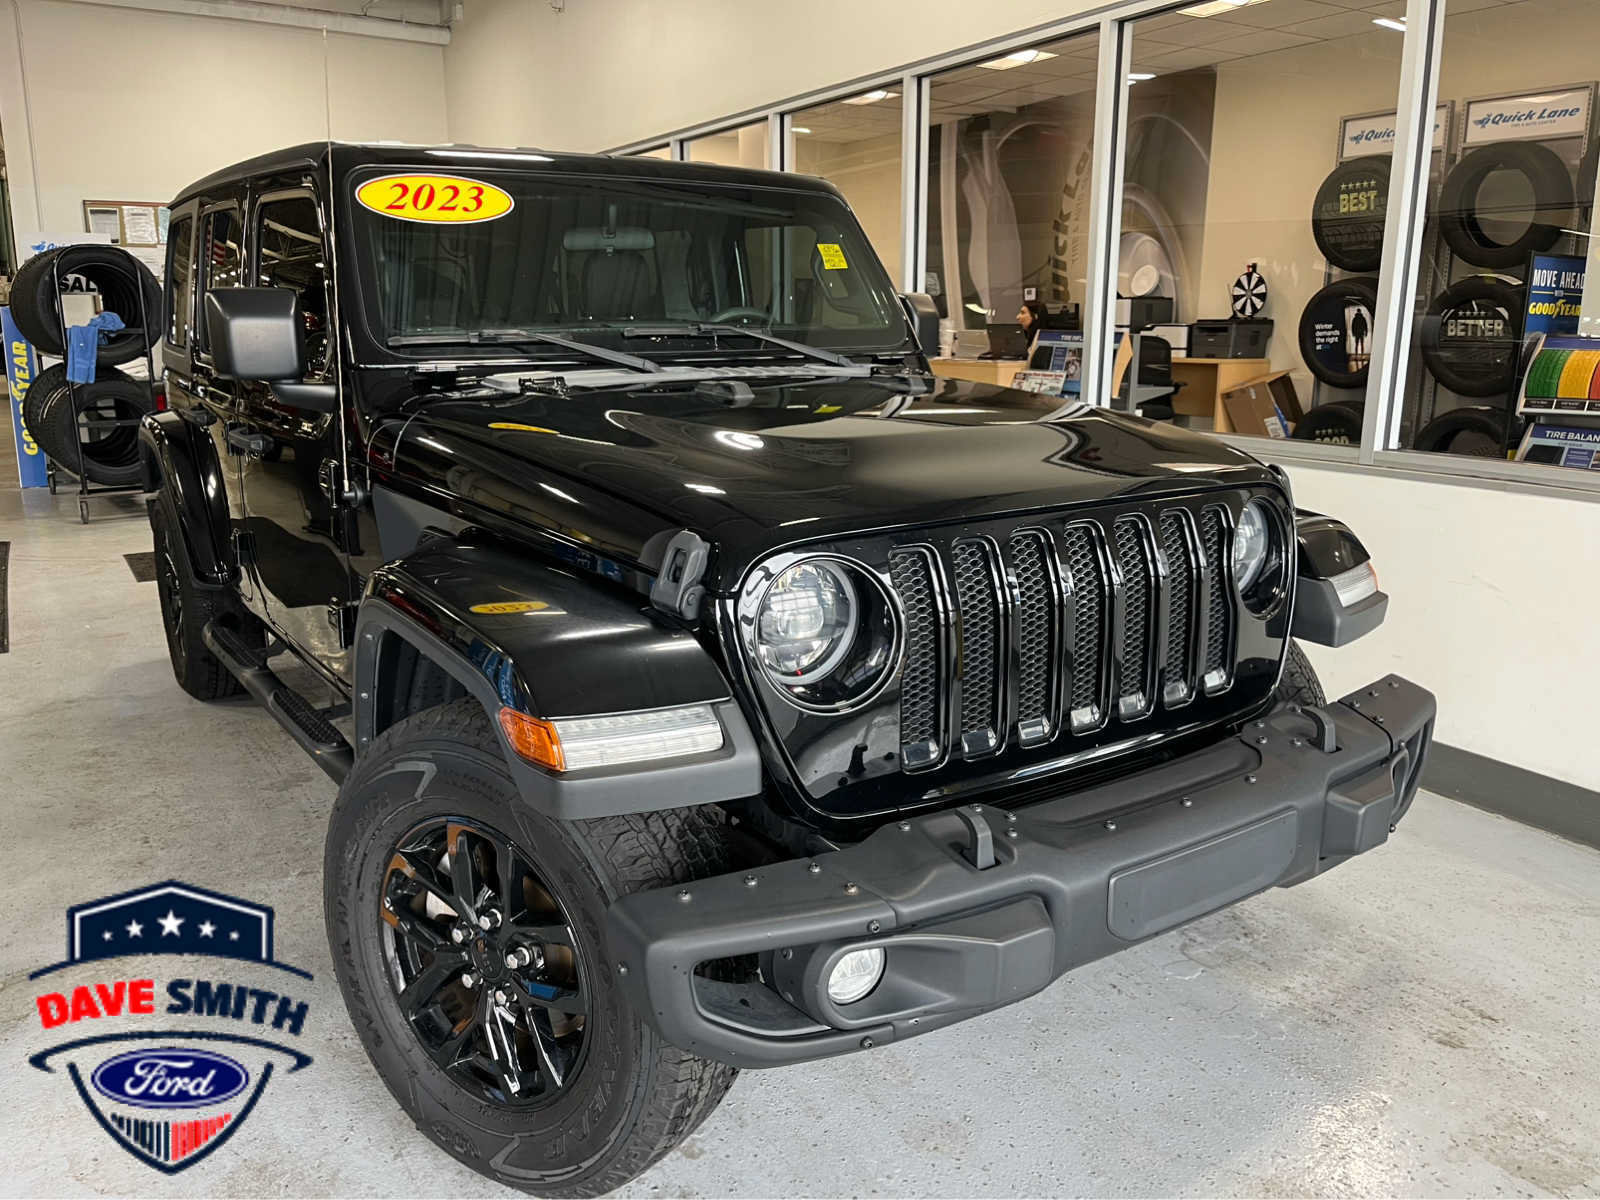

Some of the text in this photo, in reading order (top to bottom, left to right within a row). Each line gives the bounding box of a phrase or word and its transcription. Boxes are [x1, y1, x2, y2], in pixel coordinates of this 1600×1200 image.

[1490, 110, 1536, 125] Quick
[1538, 107, 1580, 120] Lane
[1365, 128, 1396, 141] Quic
[384, 183, 484, 213] 2023
[1339, 190, 1377, 213] BEST
[1048, 207, 1071, 304] uick
[60, 276, 98, 293] SAL
[1532, 269, 1585, 290] MOVE AHEAD
[1528, 298, 1583, 319] GOODYEAR
[1447, 319, 1504, 337] BETTER
[10, 340, 39, 456] GOYEAR
[1545, 430, 1600, 443] TIRE BALAN
